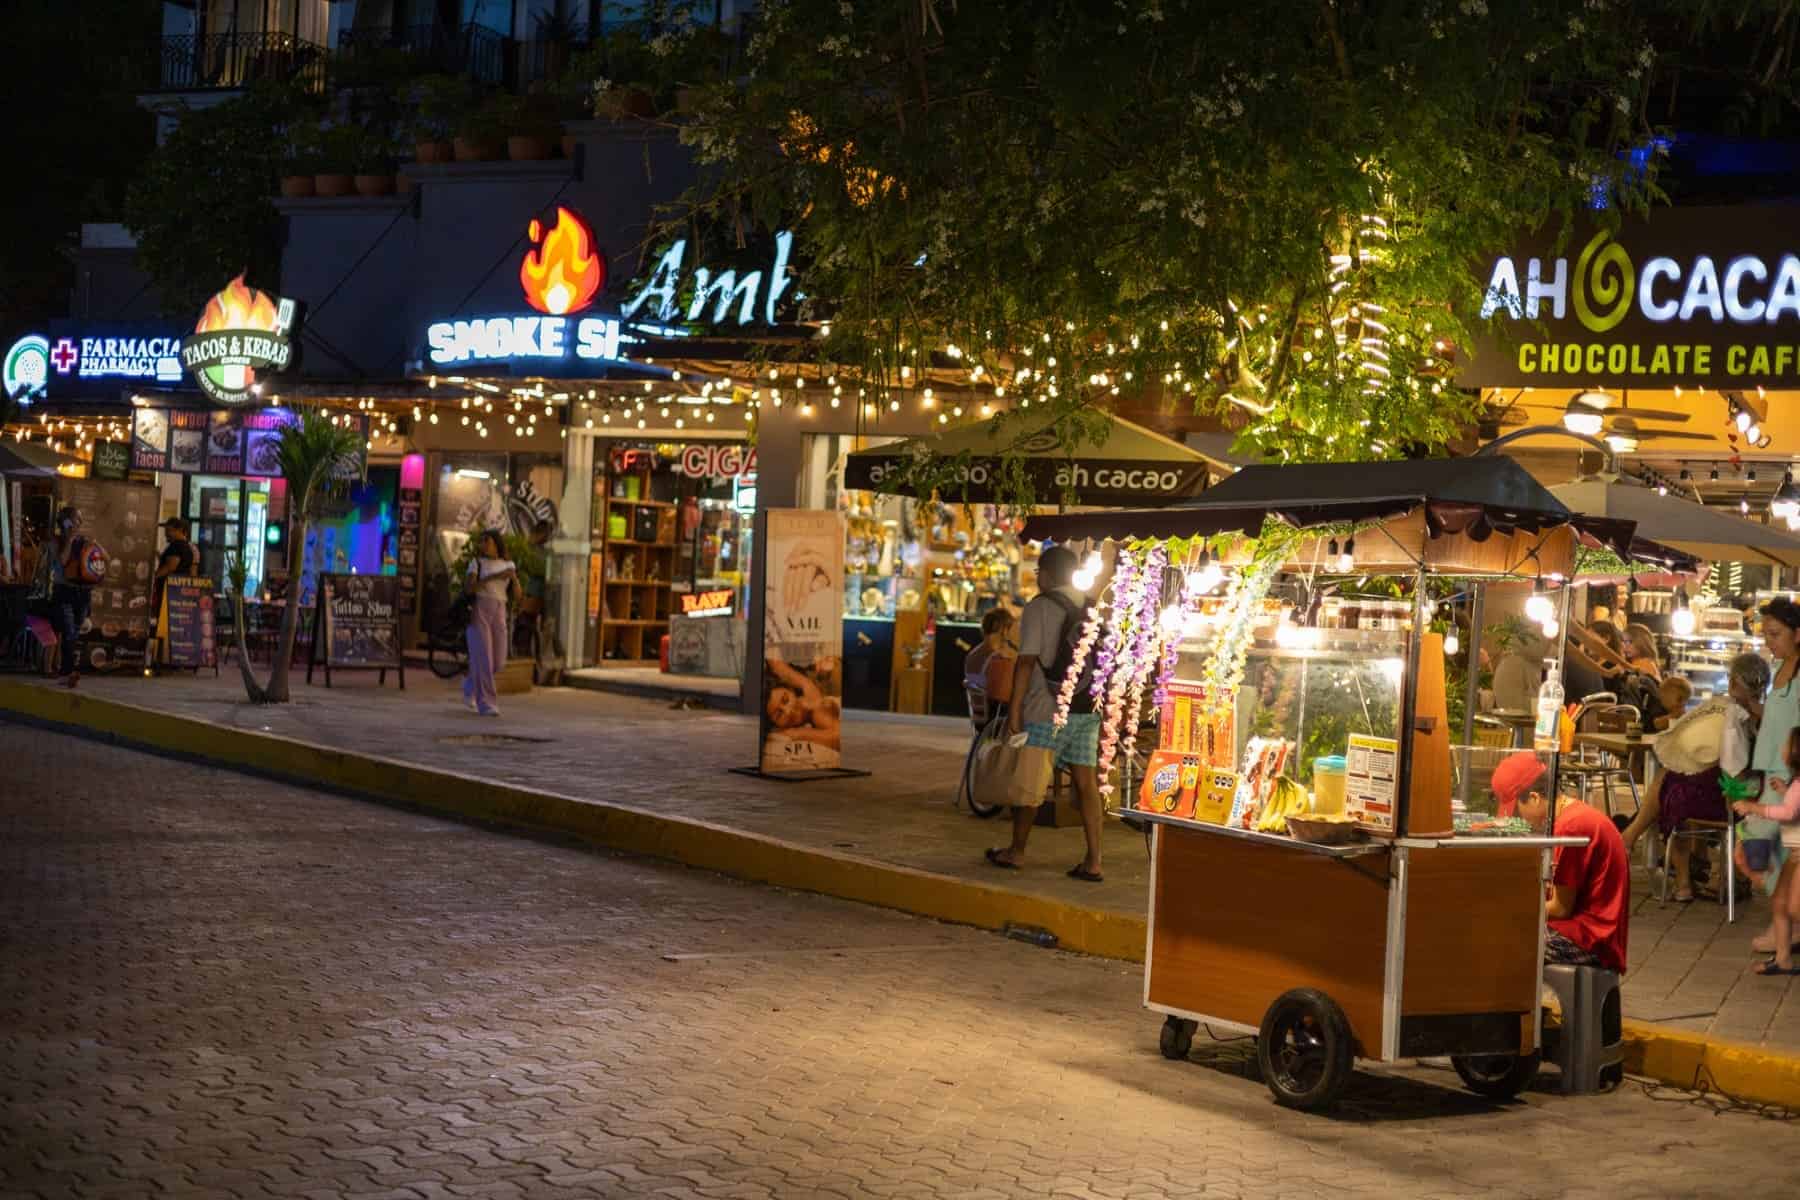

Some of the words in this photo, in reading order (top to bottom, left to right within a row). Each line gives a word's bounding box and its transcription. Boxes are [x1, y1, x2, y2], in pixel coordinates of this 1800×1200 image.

[1480, 256, 1568, 321] AH
[1638, 254, 1800, 323] CACA
[81, 337, 181, 357] FARMACIA
[183, 337, 227, 366] TACOS
[229, 335, 240, 356] &
[243, 336, 289, 364] KEBAB
[427, 316, 565, 363] SMOKE
[80, 357, 157, 371] PHARMACY
[1518, 343, 1712, 375] CHOCOLATE
[1726, 344, 1800, 376] CAF
[136, 451, 165, 469] Tacos
[1055, 463, 1089, 487] ah
[1094, 468, 1179, 491] cacao
[333, 597, 363, 616] Tattoo
[680, 589, 731, 612] RAW
